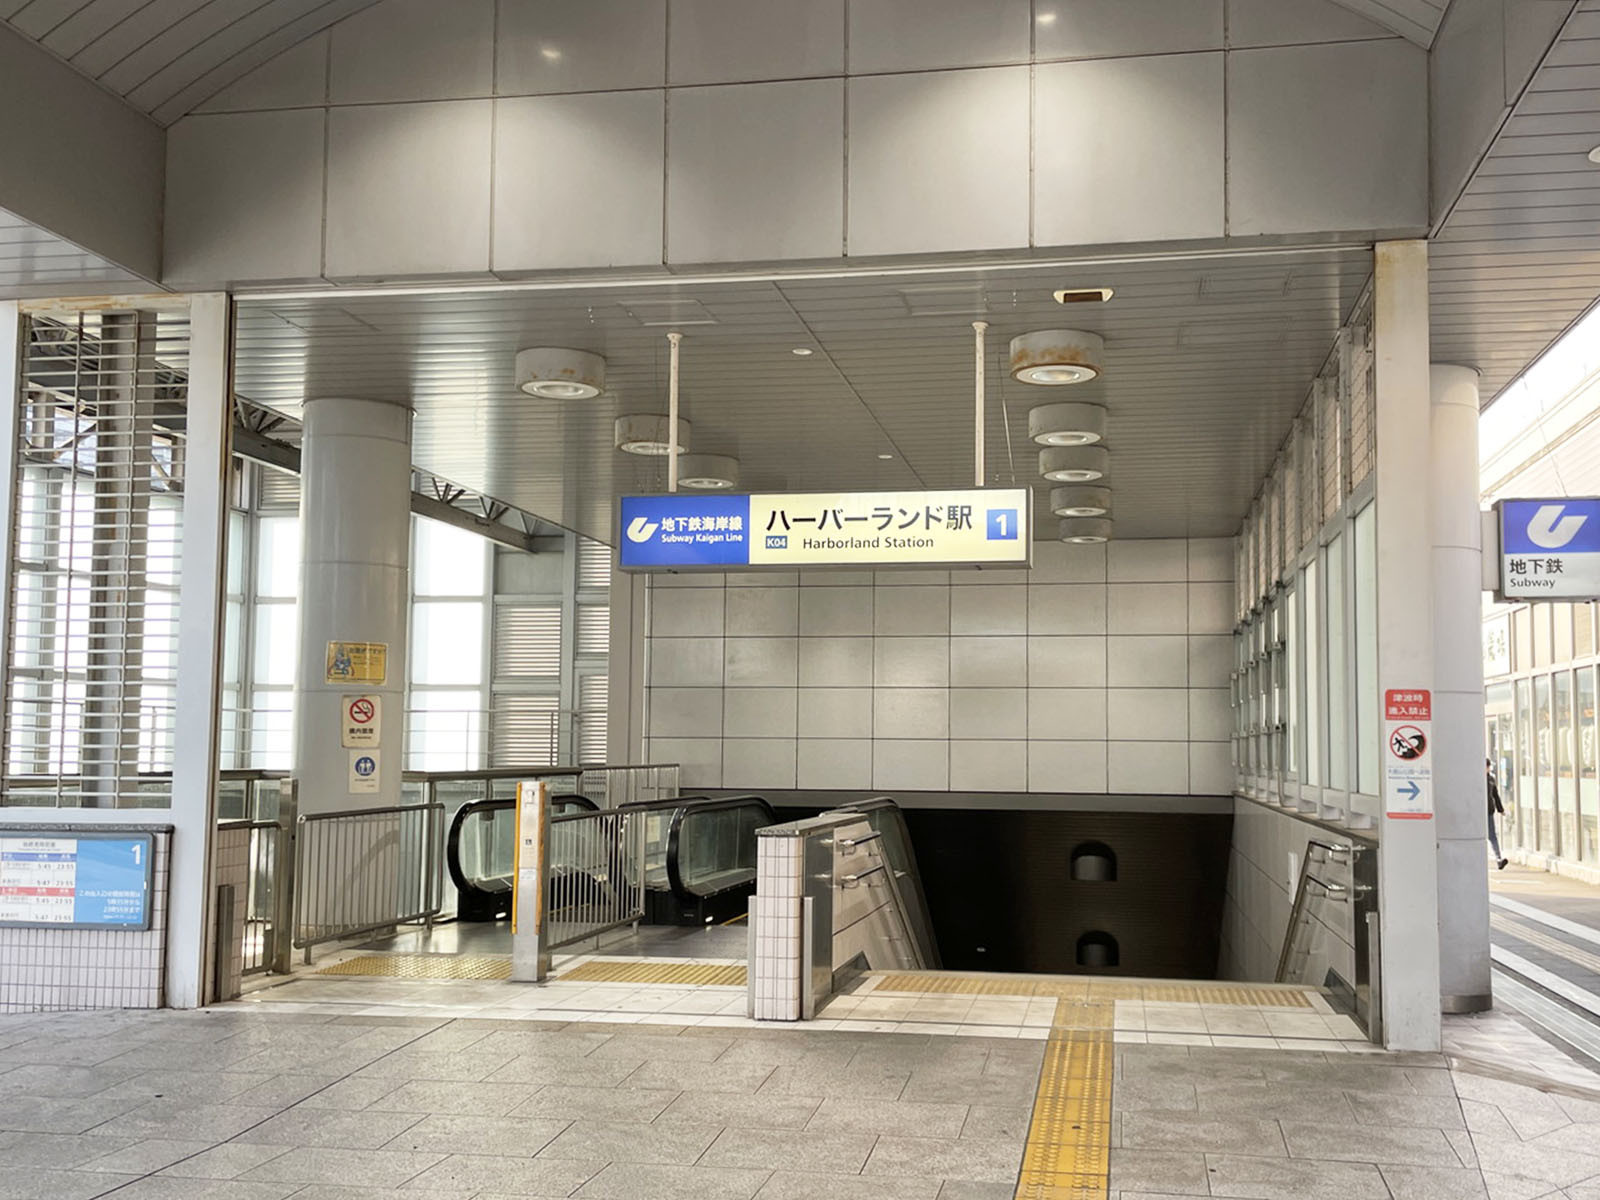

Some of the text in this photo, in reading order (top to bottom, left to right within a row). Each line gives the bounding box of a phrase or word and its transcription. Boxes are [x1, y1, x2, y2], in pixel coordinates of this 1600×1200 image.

[661, 516, 743, 532] 地下鉄海岸線
[766, 505, 972, 531] ハーバーランド駅
[995, 513, 1008, 537] 1
[661, 533, 743, 544] Subway Kaigan Line
[766, 537, 786, 548] K04
[803, 535, 934, 549] Harborland Station
[1509, 558, 1564, 575] 地下鉄
[1510, 577, 1556, 589] Subway
[131, 844, 141, 865] 1
